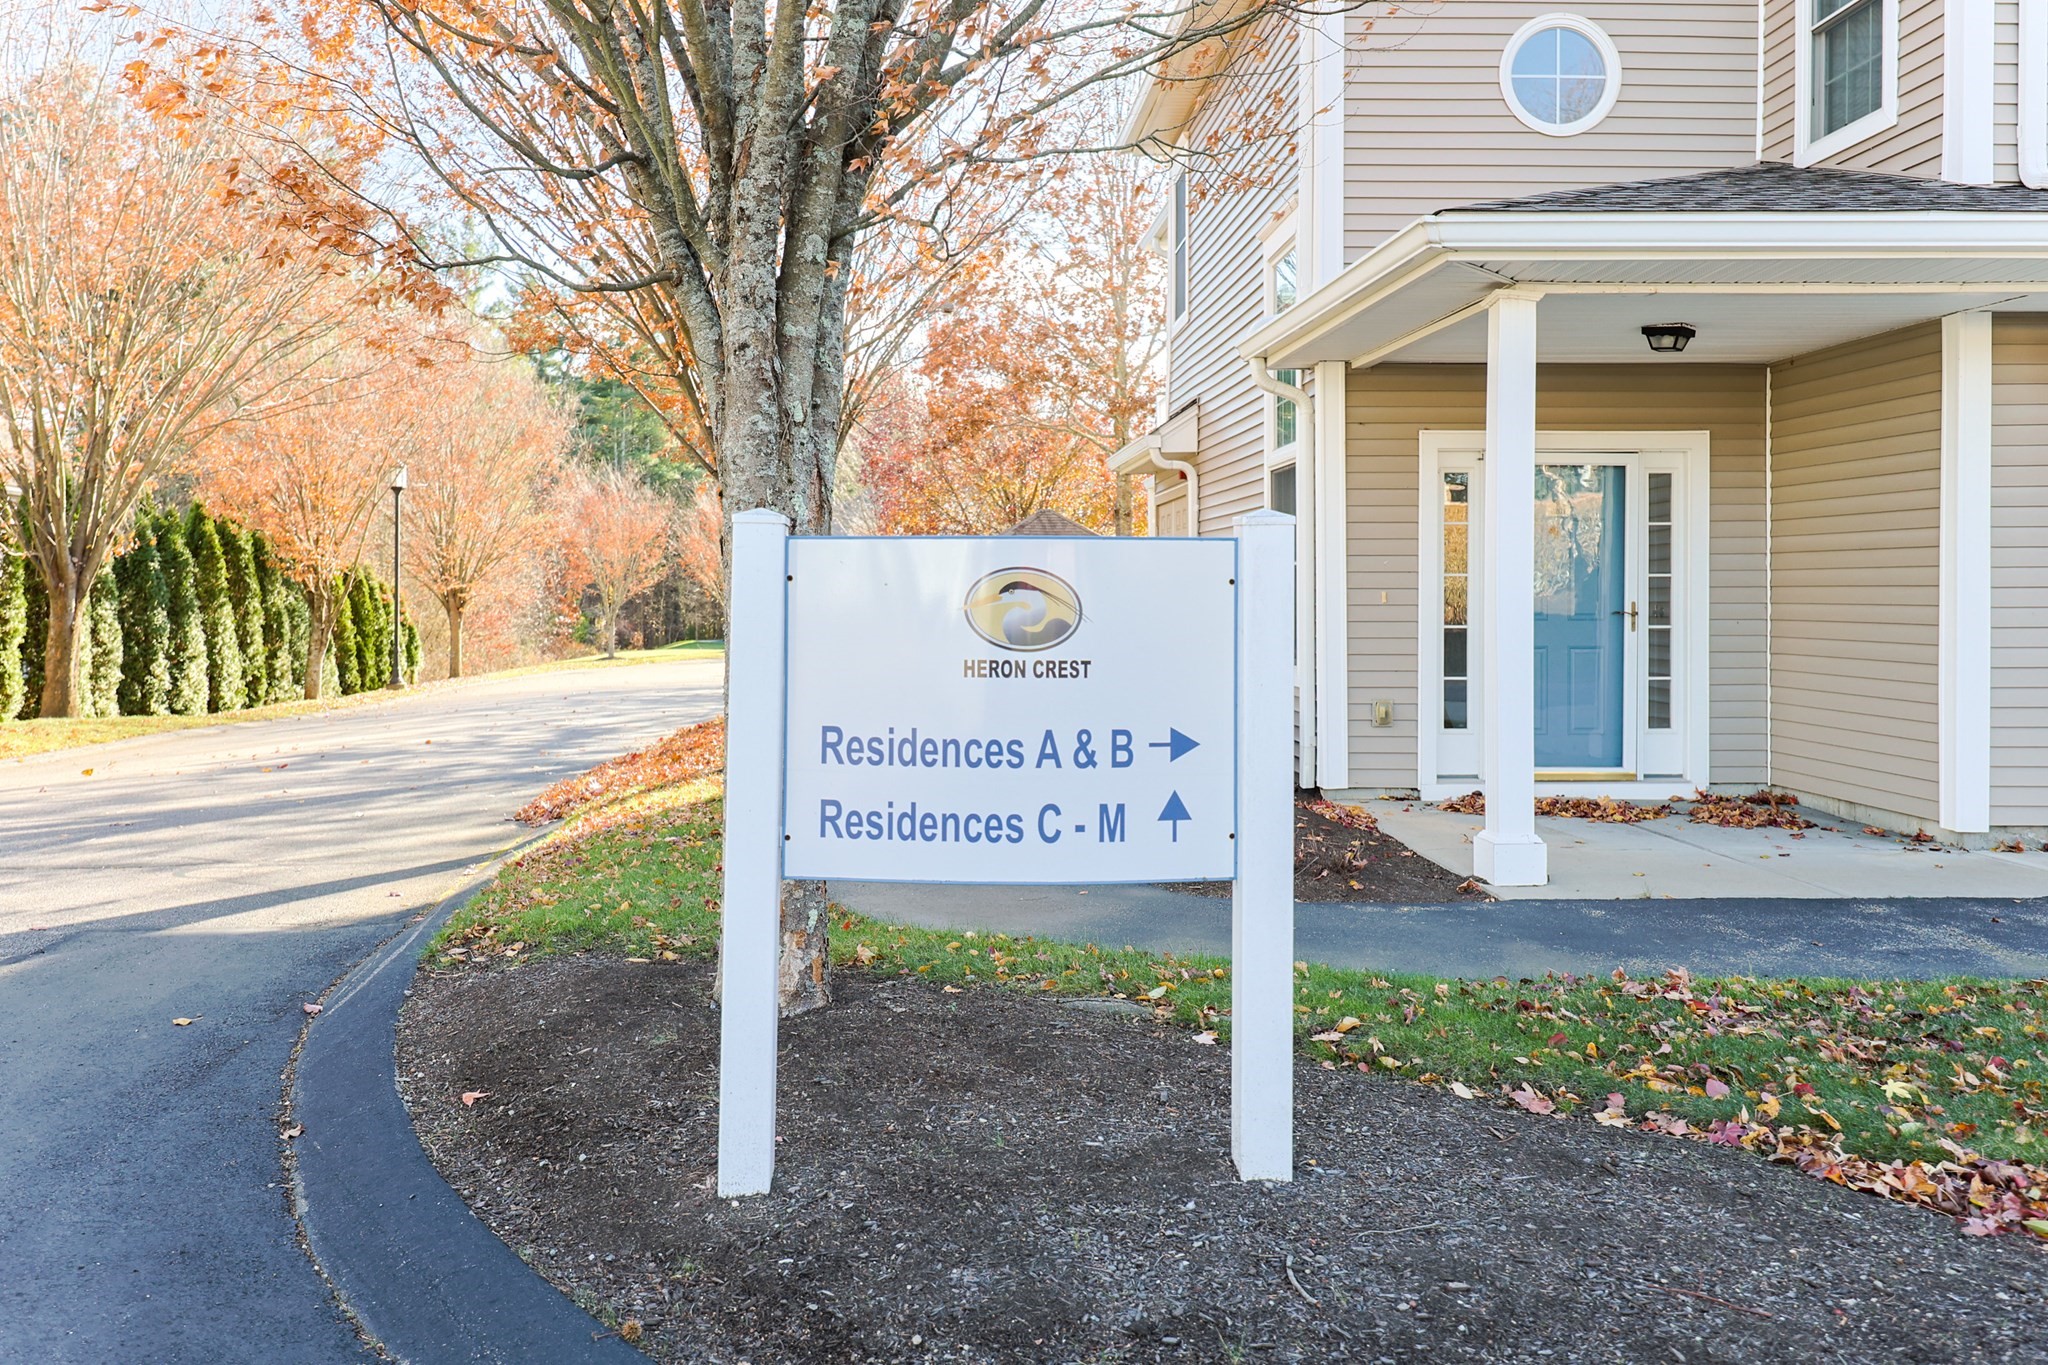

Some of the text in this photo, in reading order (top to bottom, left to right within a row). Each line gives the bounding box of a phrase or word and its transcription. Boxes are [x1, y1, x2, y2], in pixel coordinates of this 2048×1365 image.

[964, 659, 1092, 679] HERON CREST
[821, 726, 1134, 769] Residences A & B
[821, 799, 1024, 844] Residences
[1037, 803, 1062, 844] C
[1100, 803, 1126, 843] M
